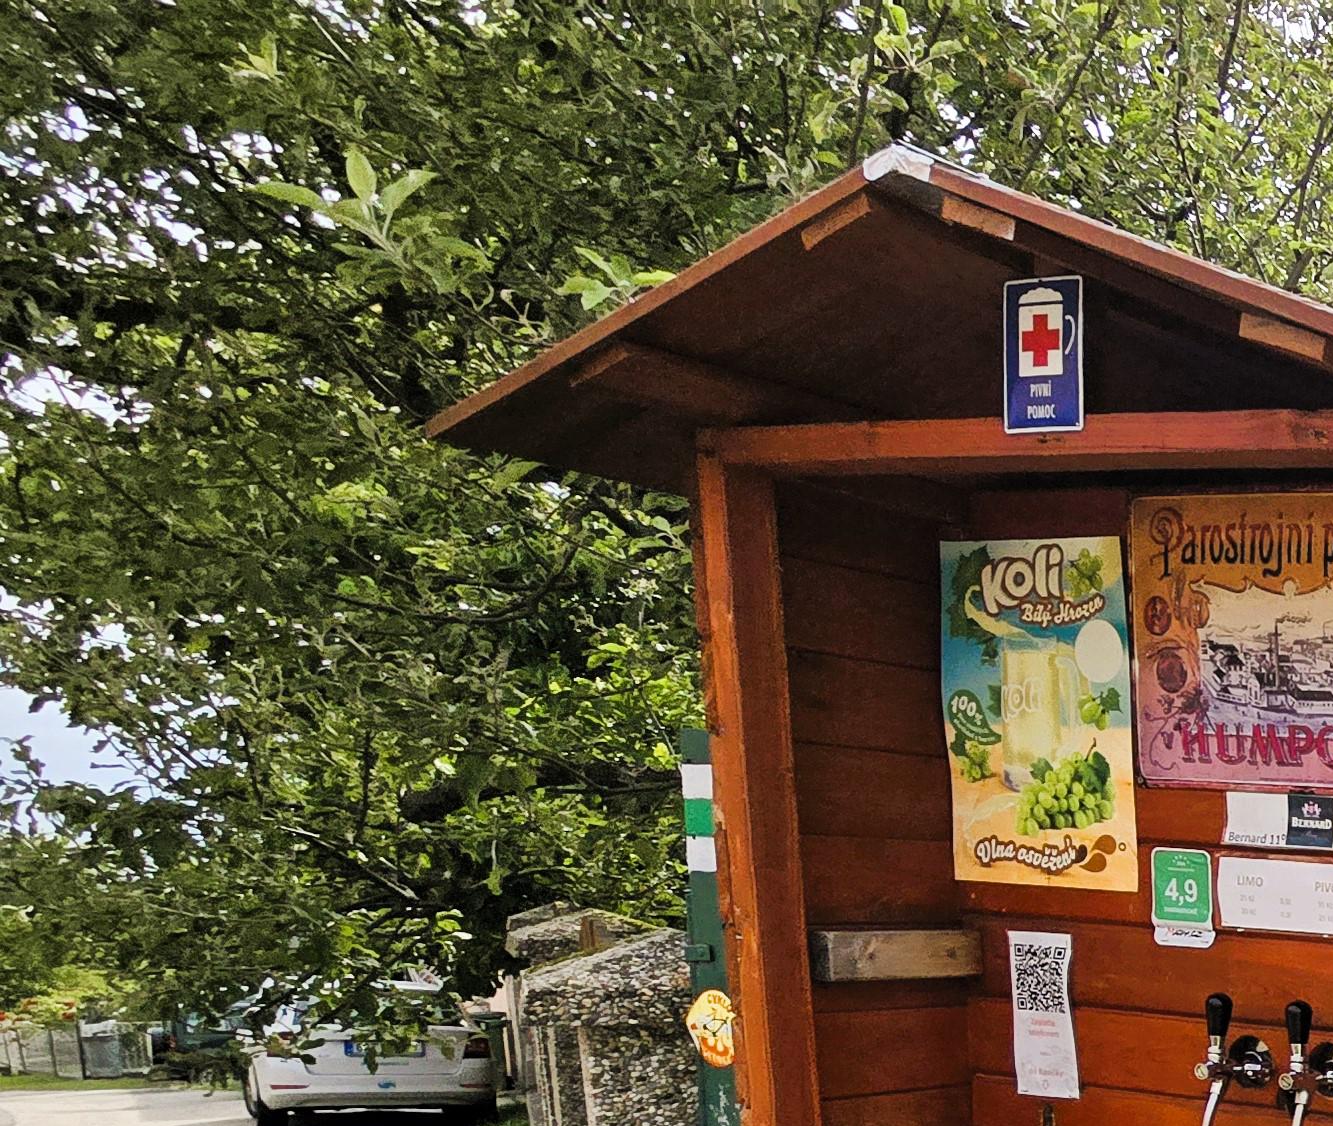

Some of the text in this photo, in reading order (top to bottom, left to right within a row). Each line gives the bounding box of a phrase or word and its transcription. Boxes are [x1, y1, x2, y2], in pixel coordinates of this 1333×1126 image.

[1030, 380, 1052, 398] PIVNÍ
[1027, 404, 1056, 419] POMOC
[1053, 595, 1104, 623] Hrozen
[951, 695, 982, 725] 100%
[1291, 817, 1332, 830] BERNARD
[1228, 832, 1267, 845] Bernard
[976, 839, 1015, 863] Vlna
[1237, 876, 1263, 887] LIMO
[1164, 878, 1198, 906] 4,9
